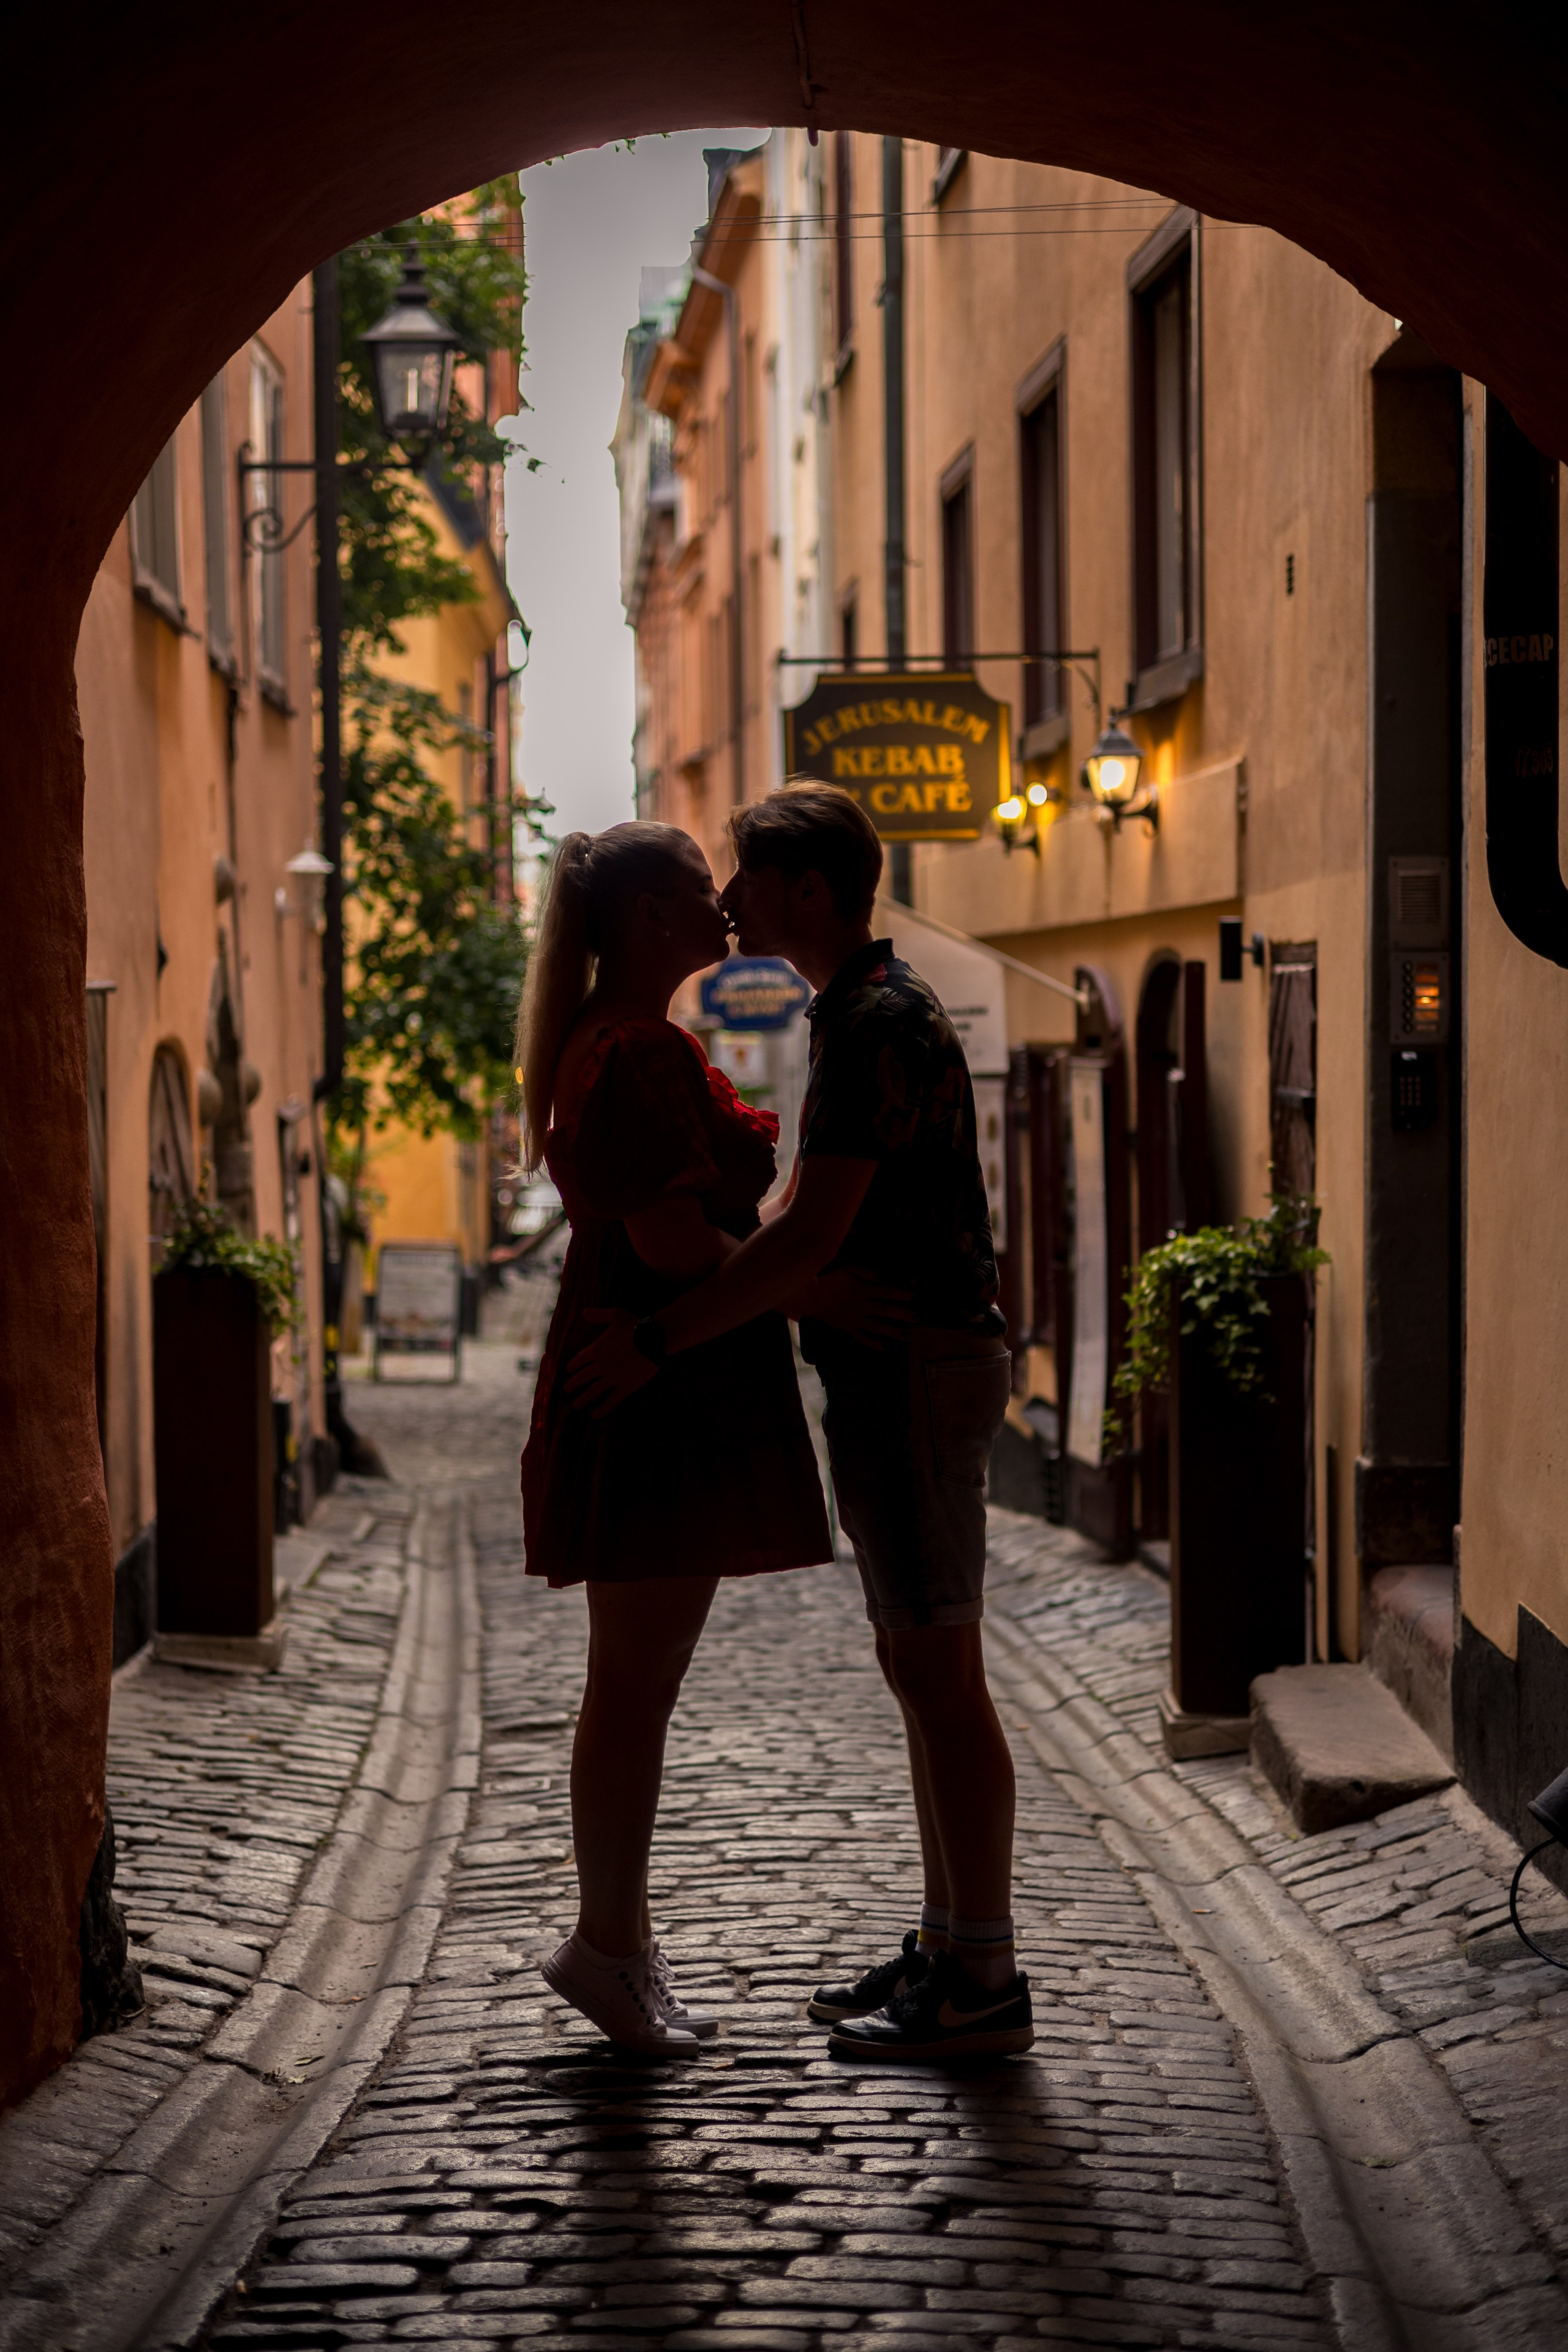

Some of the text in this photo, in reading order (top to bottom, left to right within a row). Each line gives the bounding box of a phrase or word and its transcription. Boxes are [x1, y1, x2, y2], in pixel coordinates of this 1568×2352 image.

[1484, 633, 1554, 668] CECAP
[802, 698, 990, 756] JERUSALEM
[832, 744, 965, 777] KEBAB
[869, 773, 973, 813] CAFÉ
